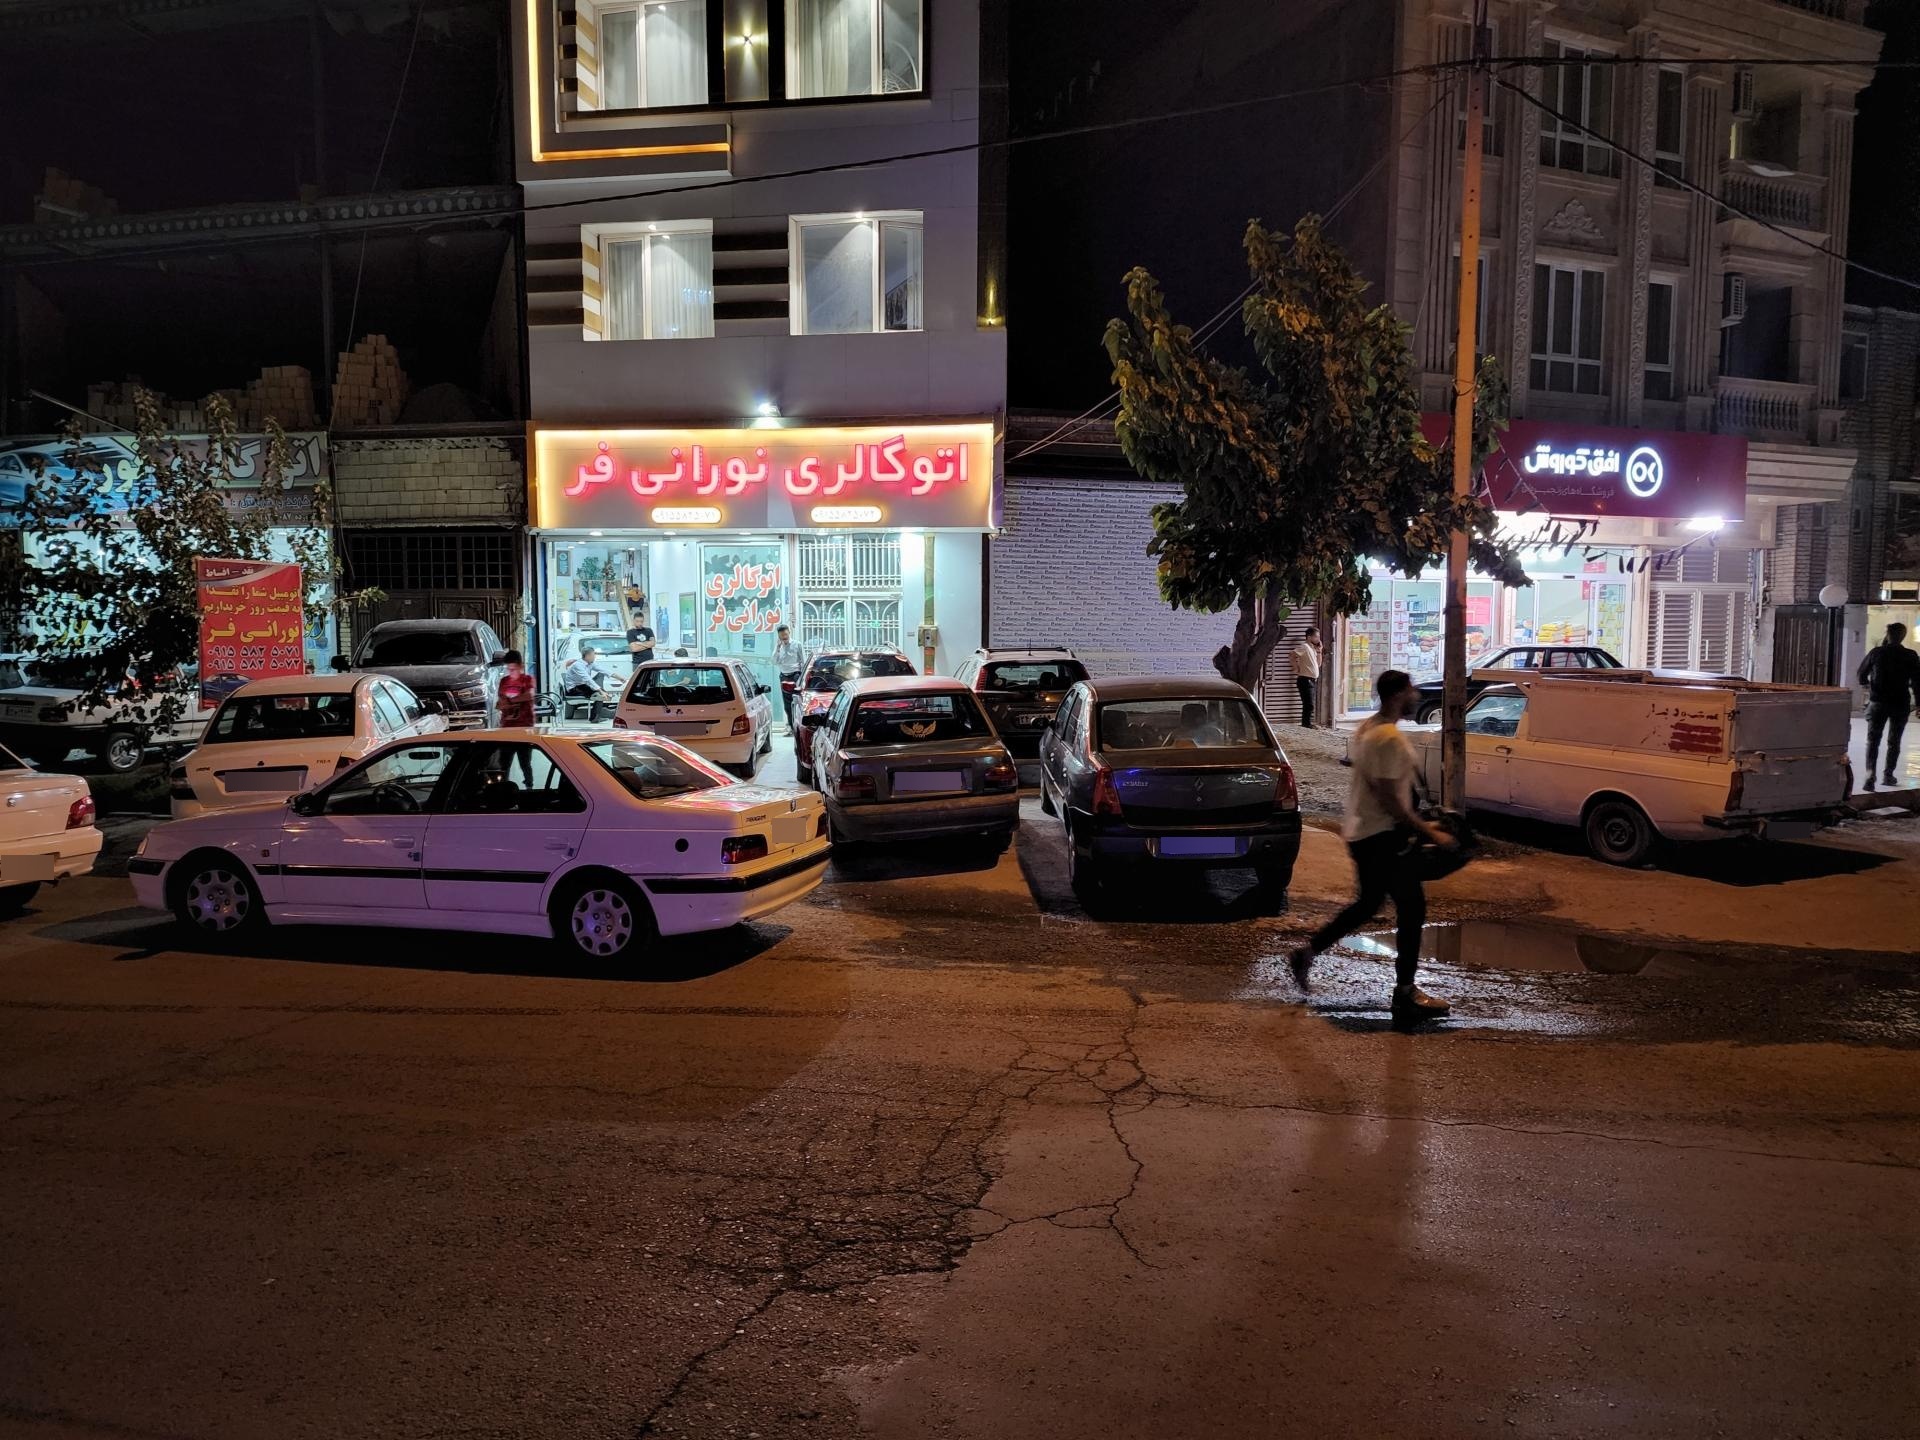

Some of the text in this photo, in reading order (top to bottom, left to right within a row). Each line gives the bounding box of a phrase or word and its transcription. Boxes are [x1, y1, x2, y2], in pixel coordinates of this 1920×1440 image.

[1524, 445, 1619, 476] افق کوروش
[563, 441, 617, 497] فر
[630, 445, 770, 497] نورانی
[242, 586, 251, 600] را
[252, 586, 268, 598] شما
[250, 602, 267, 616] روز
[268, 602, 292, 615] قیمت
[292, 604, 303, 614] به
[707, 597, 783, 633] نورانی فر
[206, 618, 237, 644] فر
[240, 619, 301, 645] نورانی
[206, 645, 237, 658] ۰۹۱۵
[206, 657, 237, 671] ۰۹۱۵
